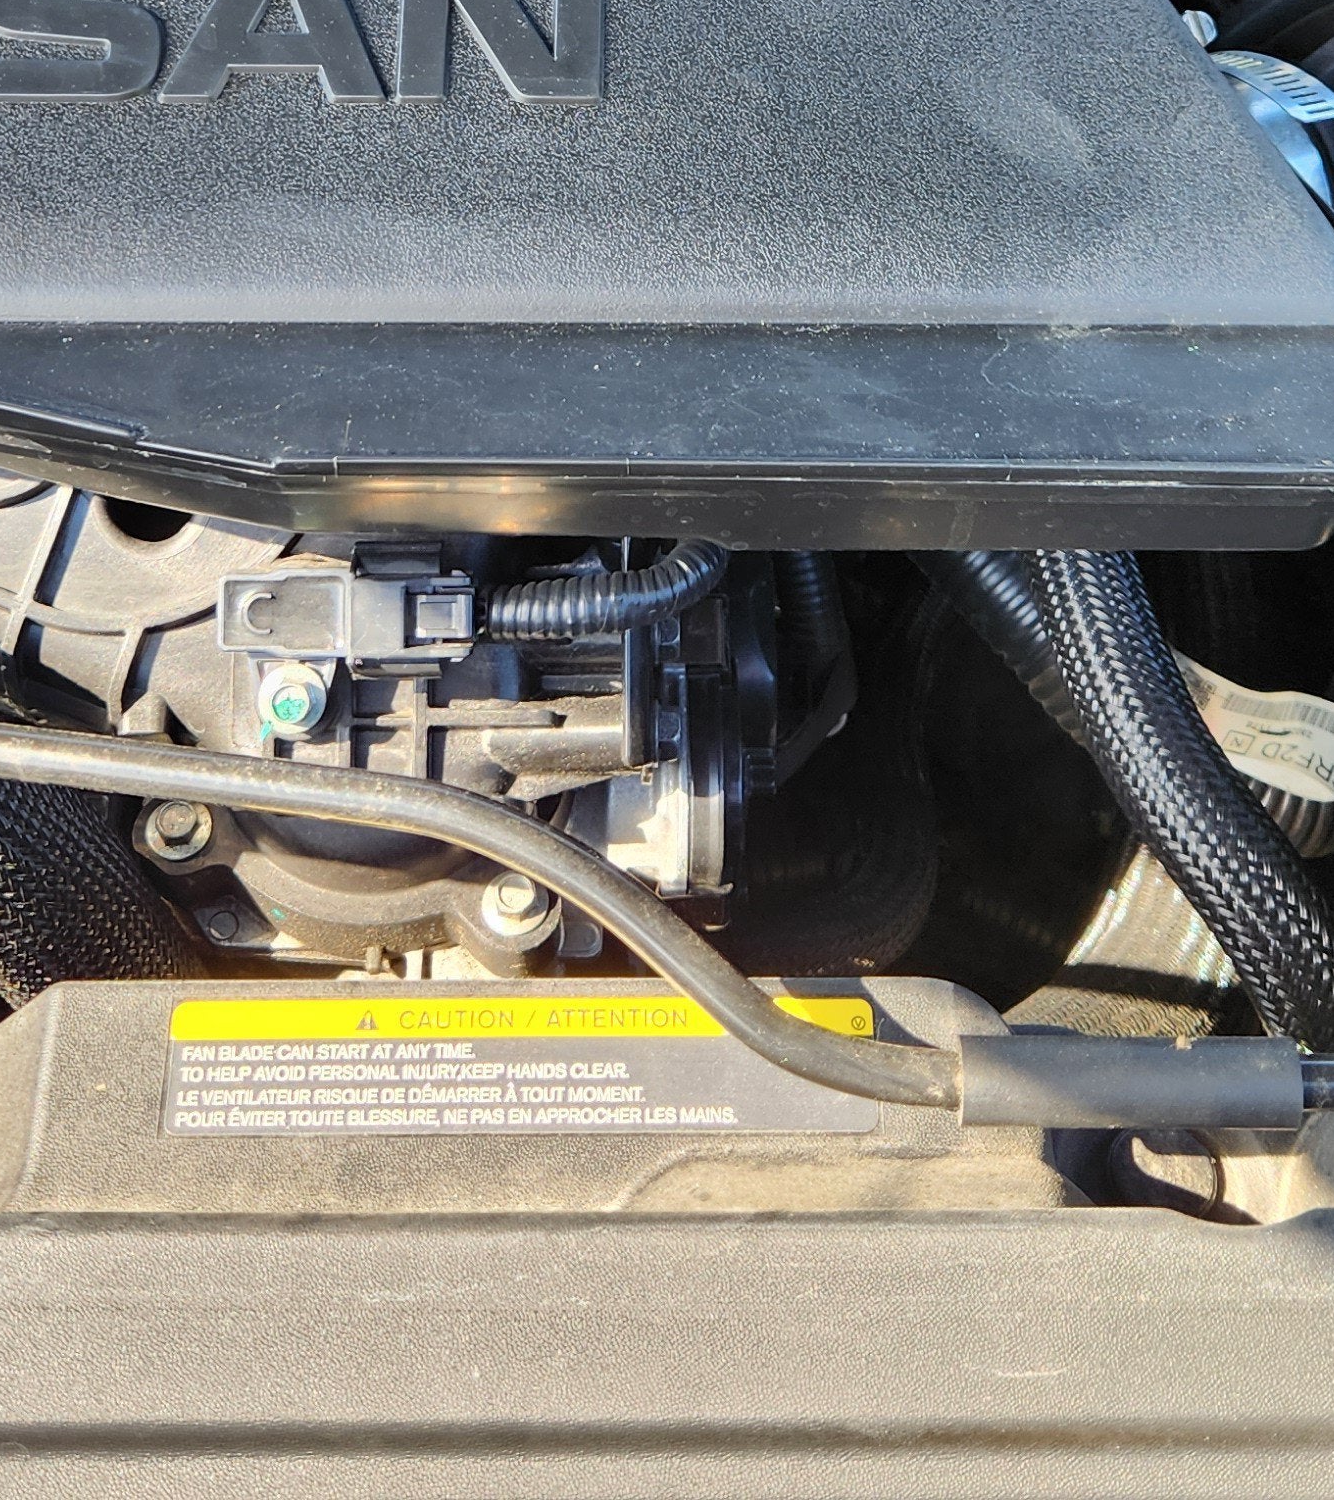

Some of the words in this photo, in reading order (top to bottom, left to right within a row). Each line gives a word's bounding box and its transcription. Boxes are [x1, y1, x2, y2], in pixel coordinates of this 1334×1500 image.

[399, 1009, 514, 1030] CAUTION
[526, 1010, 536, 1028] /
[547, 1008, 688, 1029] ATTENTION
[181, 1045, 215, 1061] FAN
[217, 1045, 274, 1061] BLADE
[275, 1044, 313, 1060] CAN
[317, 1043, 369, 1060] START
[371, 1043, 393, 1059] AT
[395, 1043, 433, 1059] ANY
[434, 1043, 476, 1059] TIME.
[180, 1066, 204, 1082] TO
[206, 1066, 251, 1082] HELP
[253, 1065, 306, 1081] AVOID
[309, 1064, 400, 1080] PERSONAL
[506, 1063, 567, 1079] HANDS
[570, 1062, 630, 1079] CLEAR.
[176, 1090, 199, 1106] LE
[202, 1088, 311, 1105] VENTILATEUR
[313, 1088, 378, 1105] RISQUE
[380, 1087, 405, 1103] DE
[408, 1083, 501, 1103] DÉMARRER
[520, 1087, 565, 1102] TOUT
[568, 1086, 646, 1102] MOMENT.
[174, 1111, 226, 1128] POUR
[228, 1107, 287, 1127] ÉVITER
[289, 1110, 345, 1126] TOUTE
[347, 1109, 441, 1128] BLESSURE,
[443, 1109, 468, 1125] NE
[470, 1109, 505, 1125] PAS
[507, 1109, 532, 1125] EN
[534, 1108, 642, 1125] APPROCHER
[645, 1107, 678, 1124] LES
[680, 1107, 738, 1125] MAINS.
